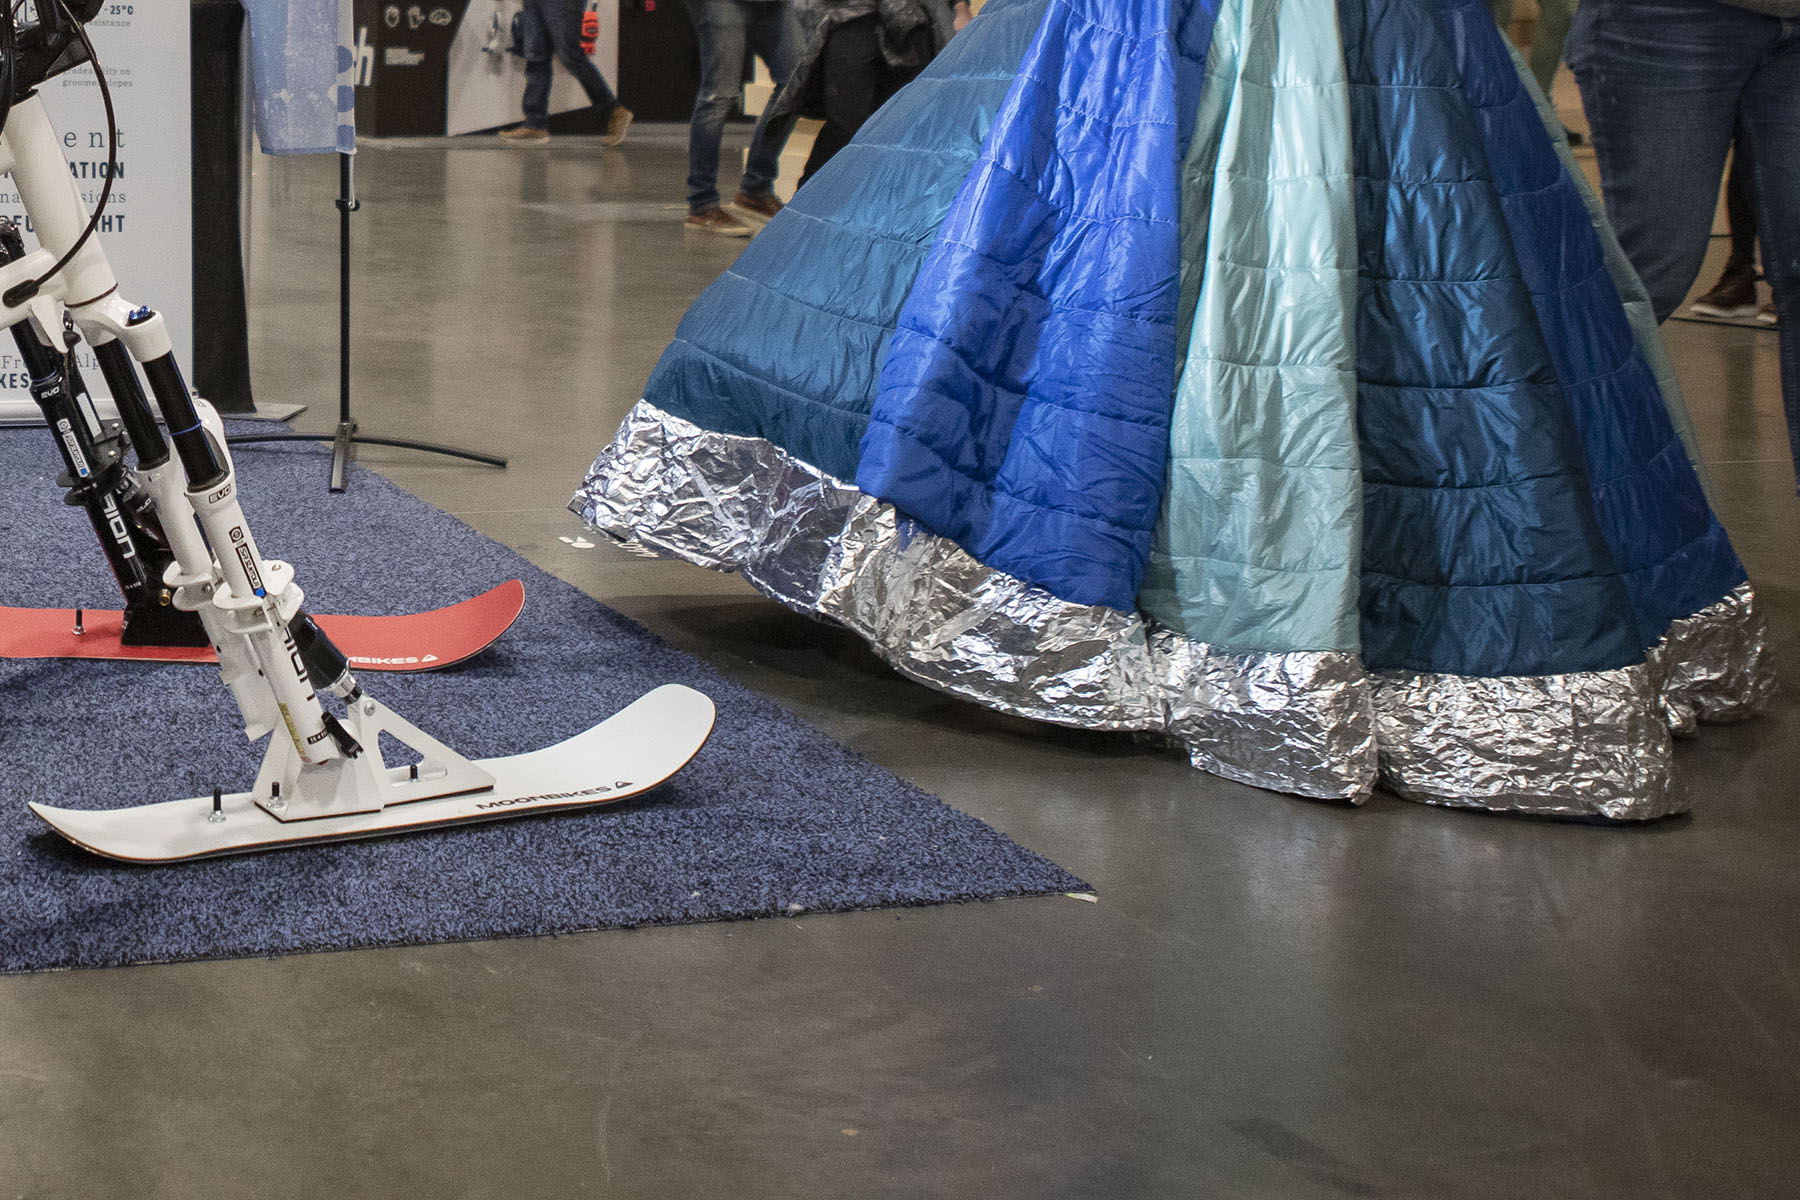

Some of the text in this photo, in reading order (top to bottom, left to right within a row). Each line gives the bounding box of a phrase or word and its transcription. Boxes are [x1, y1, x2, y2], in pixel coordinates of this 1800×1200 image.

[88, 20, 131, 28] esistance
[62, 79, 133, 88] groome lopes
[209, 483, 231, 504] EVO
[474, 785, 612, 810] MOONBIKES
